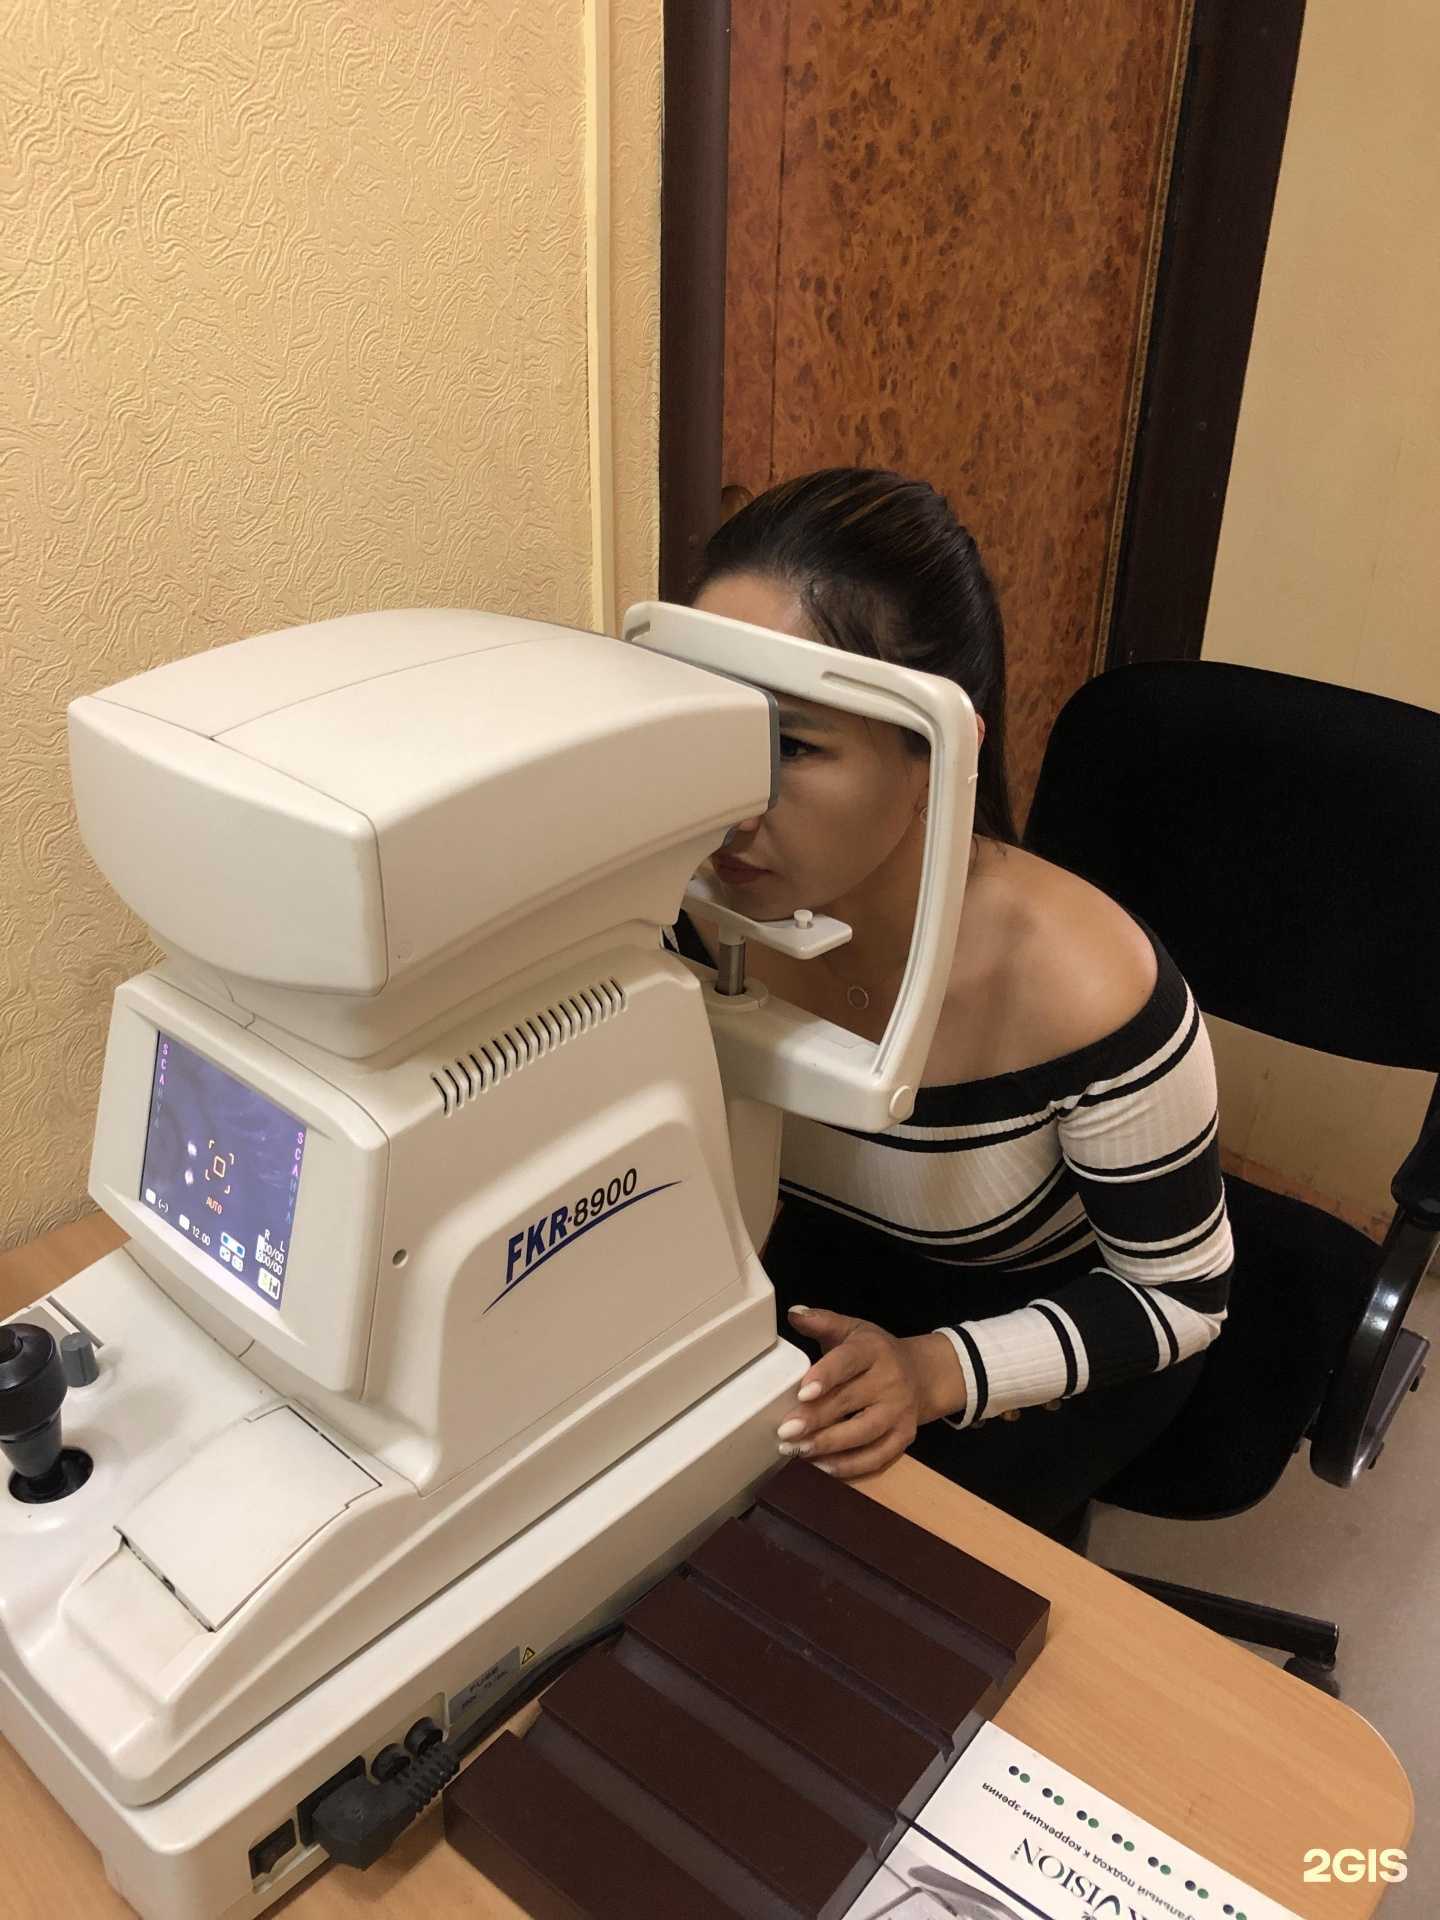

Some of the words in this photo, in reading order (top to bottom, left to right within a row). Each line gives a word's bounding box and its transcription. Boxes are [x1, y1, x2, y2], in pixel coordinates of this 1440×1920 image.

[982, 1782, 1022, 1811] зрения
[1022, 1809, 1083, 1853] коррекции
[1093, 1854, 1136, 1888] подход
